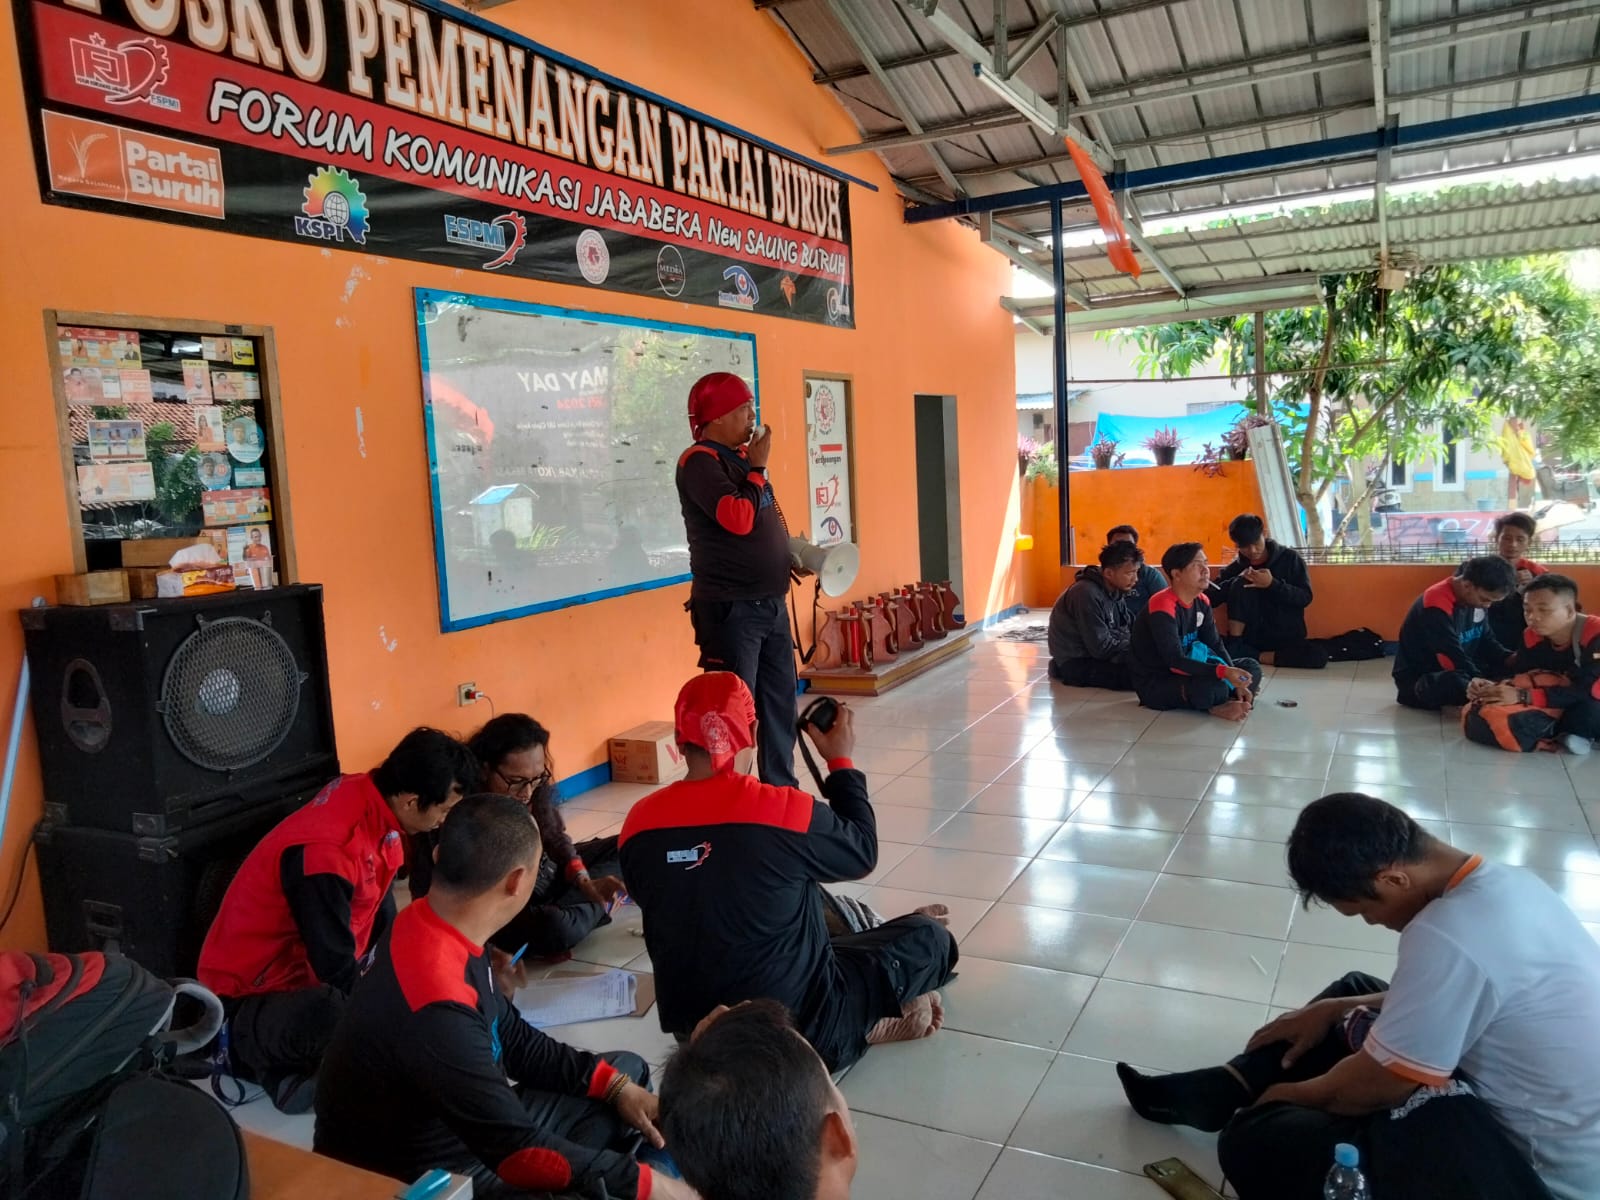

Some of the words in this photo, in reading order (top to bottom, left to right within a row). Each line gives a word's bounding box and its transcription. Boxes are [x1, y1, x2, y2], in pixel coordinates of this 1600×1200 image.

[347, 0, 665, 188] PEMENANGAN
[668, 111, 768, 220] PARTAI
[769, 153, 844, 242] BURUH
[125, 140, 219, 182] Partai
[208, 79, 373, 161] FORUM
[383, 127, 580, 213] KOMUNIKASI
[586, 185, 703, 242] JABABEKA
[707, 218, 741, 252] New
[745, 228, 798, 264] SAUNG
[800, 243, 846, 275] BURUH
[128, 168, 220, 208] Buruh
[294, 216, 344, 241] KSPI
[444, 214, 506, 247] FSPMI
